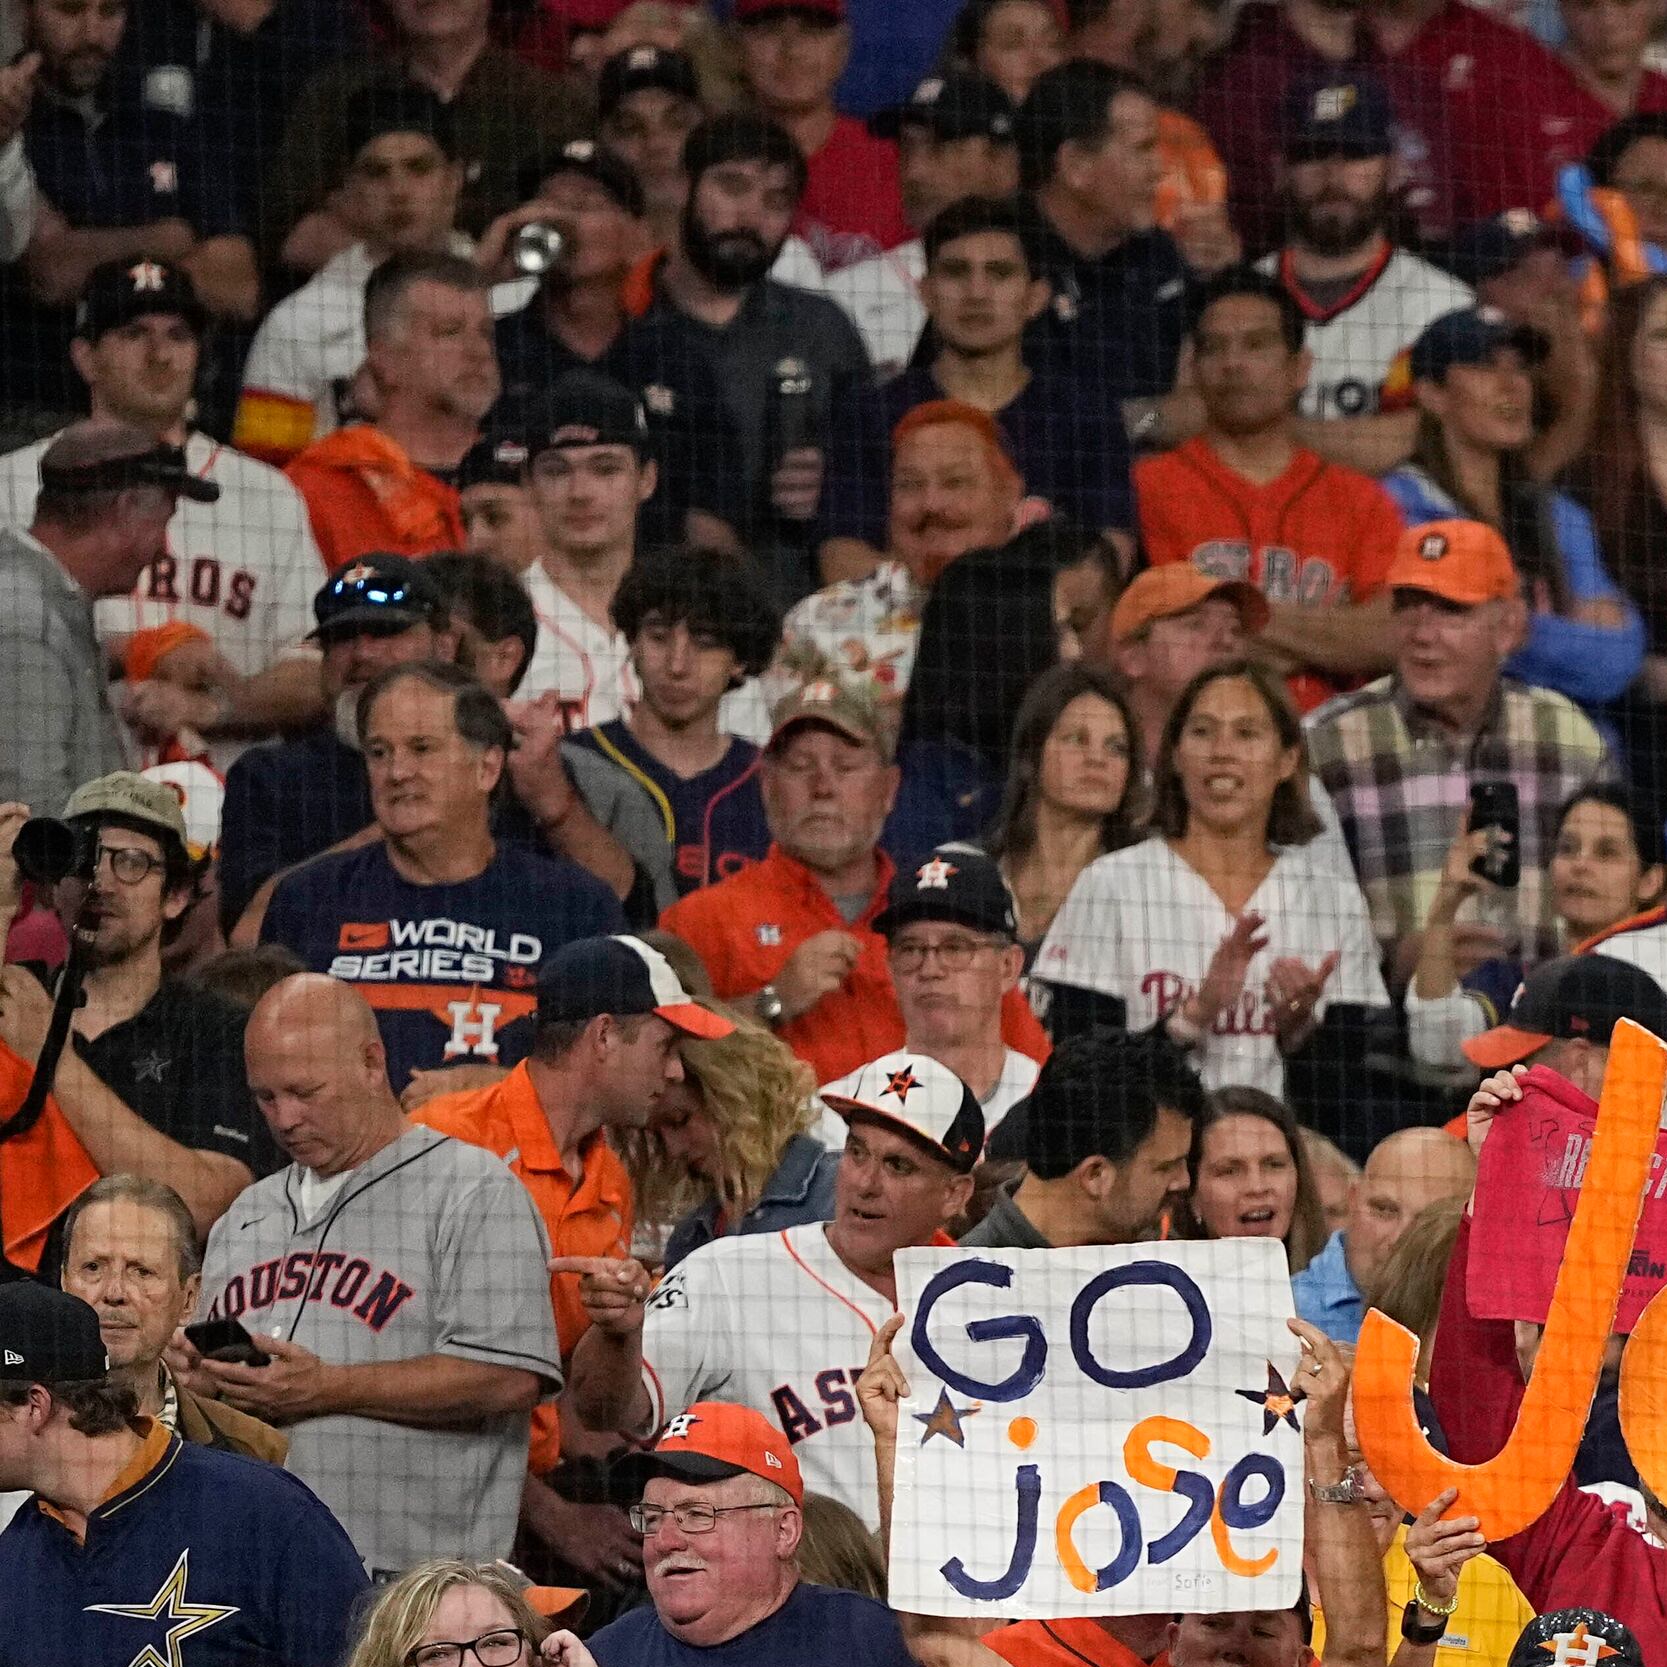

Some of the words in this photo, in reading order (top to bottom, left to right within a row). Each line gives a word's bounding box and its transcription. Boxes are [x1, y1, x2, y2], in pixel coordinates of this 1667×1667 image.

[328, 948, 494, 982] SERIES
[390, 917, 542, 964] WORLD
[445, 1001, 501, 1055] H
[912, 1258, 1212, 1403] GO
